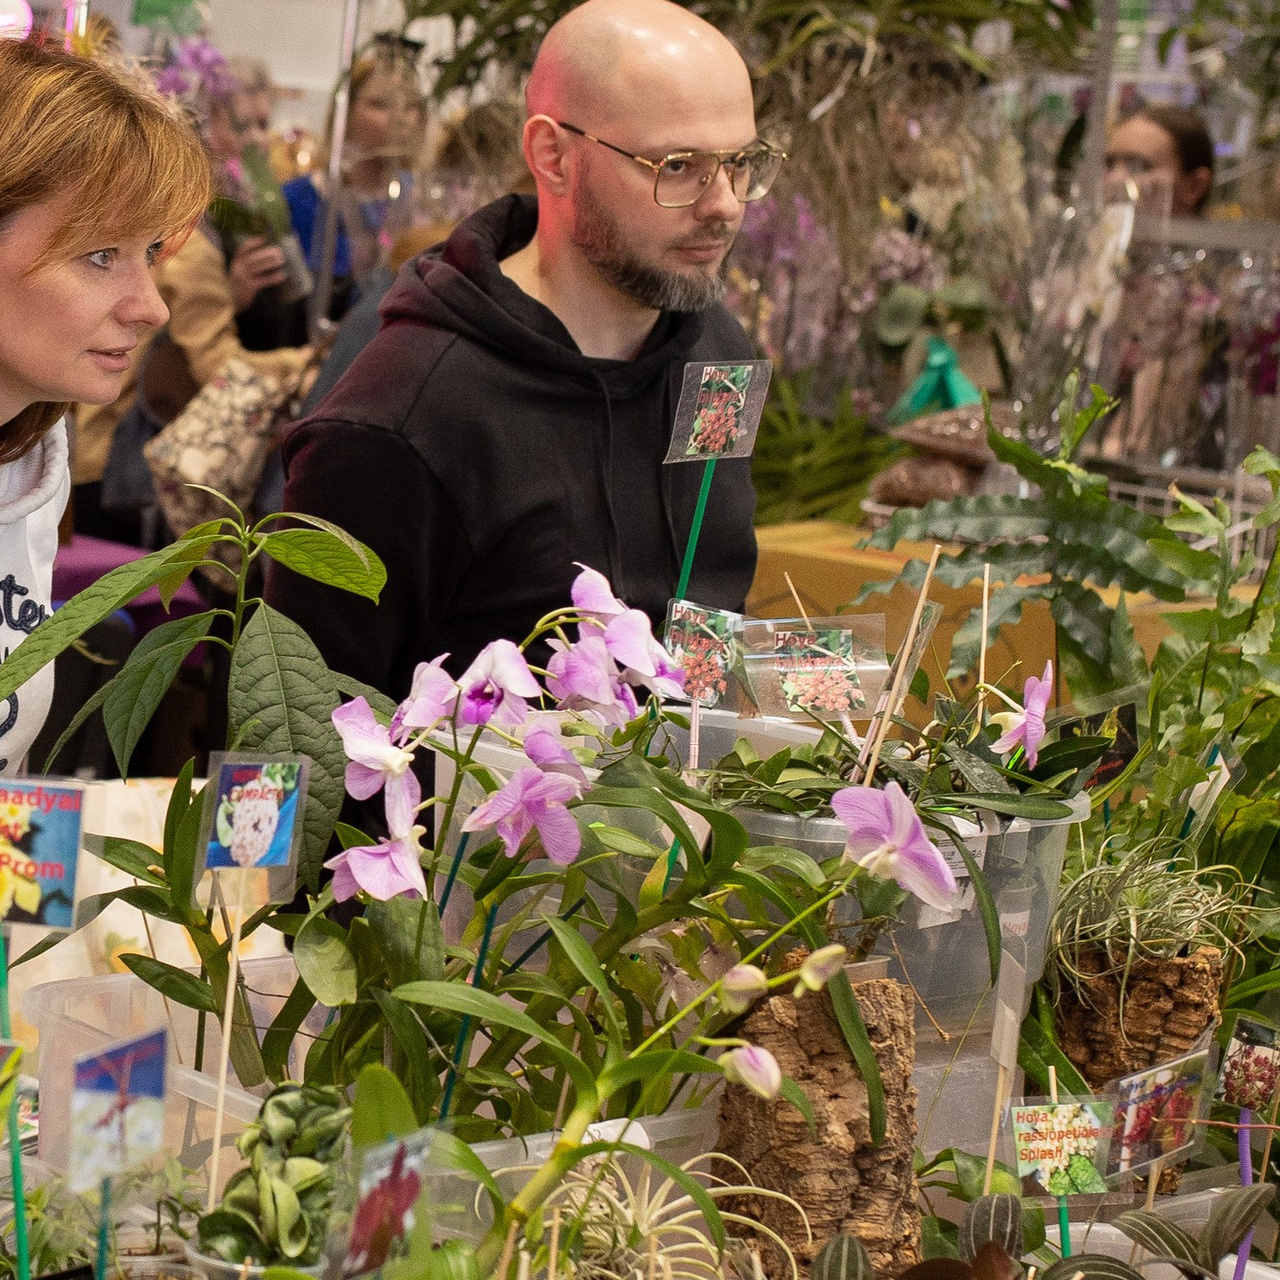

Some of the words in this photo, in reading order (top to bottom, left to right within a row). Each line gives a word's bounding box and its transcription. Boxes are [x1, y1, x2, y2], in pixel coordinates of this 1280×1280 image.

[674, 605, 707, 624] Hoya
[775, 633, 816, 648] Hoya
[1016, 1111, 1048, 1124] Hoya
[1020, 1148, 1063, 1163] Splash
